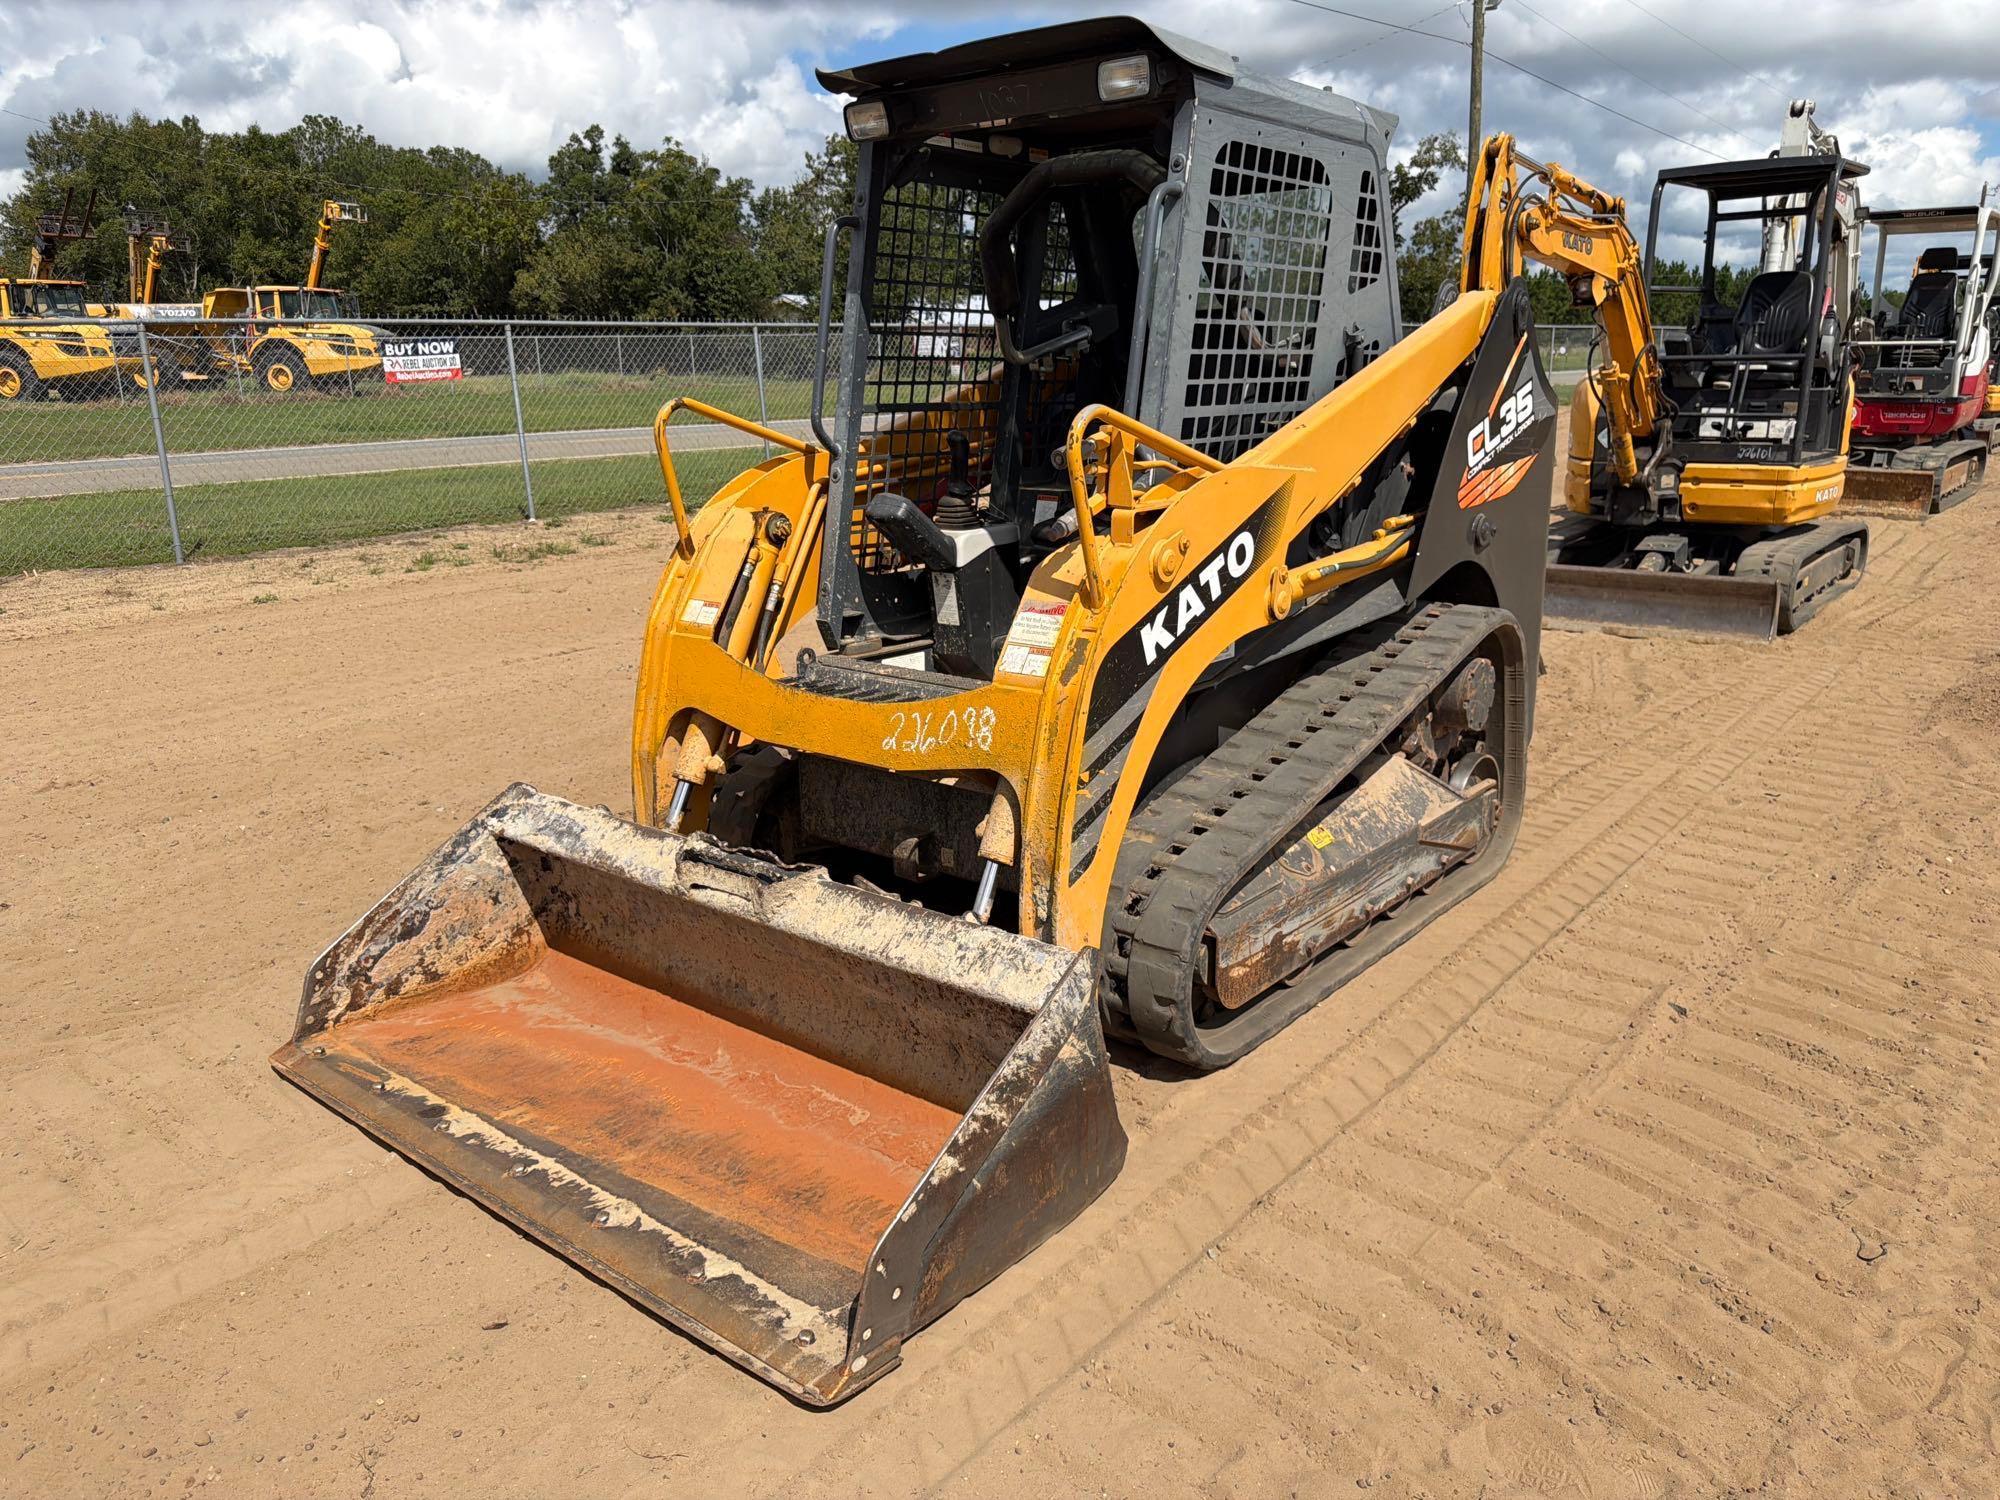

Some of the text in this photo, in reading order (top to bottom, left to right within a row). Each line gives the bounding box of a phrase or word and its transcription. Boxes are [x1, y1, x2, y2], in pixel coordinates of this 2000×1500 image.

[1901, 210, 1945, 218] TAKEUCHI
[1562, 231, 1593, 256] KATO
[159, 309, 196, 317] VOLVO
[385, 341, 454, 356] BUY NOW
[402, 358, 421, 369] REBEL
[422, 357, 448, 368] AUCTION
[1467, 380, 1534, 468] CL35
[1467, 414, 1536, 480] COMPACT TRACK LOADER
[1815, 486, 1839, 503] KATO
[1140, 531, 1255, 666] KATO
[882, 705, 996, 754] 226098
